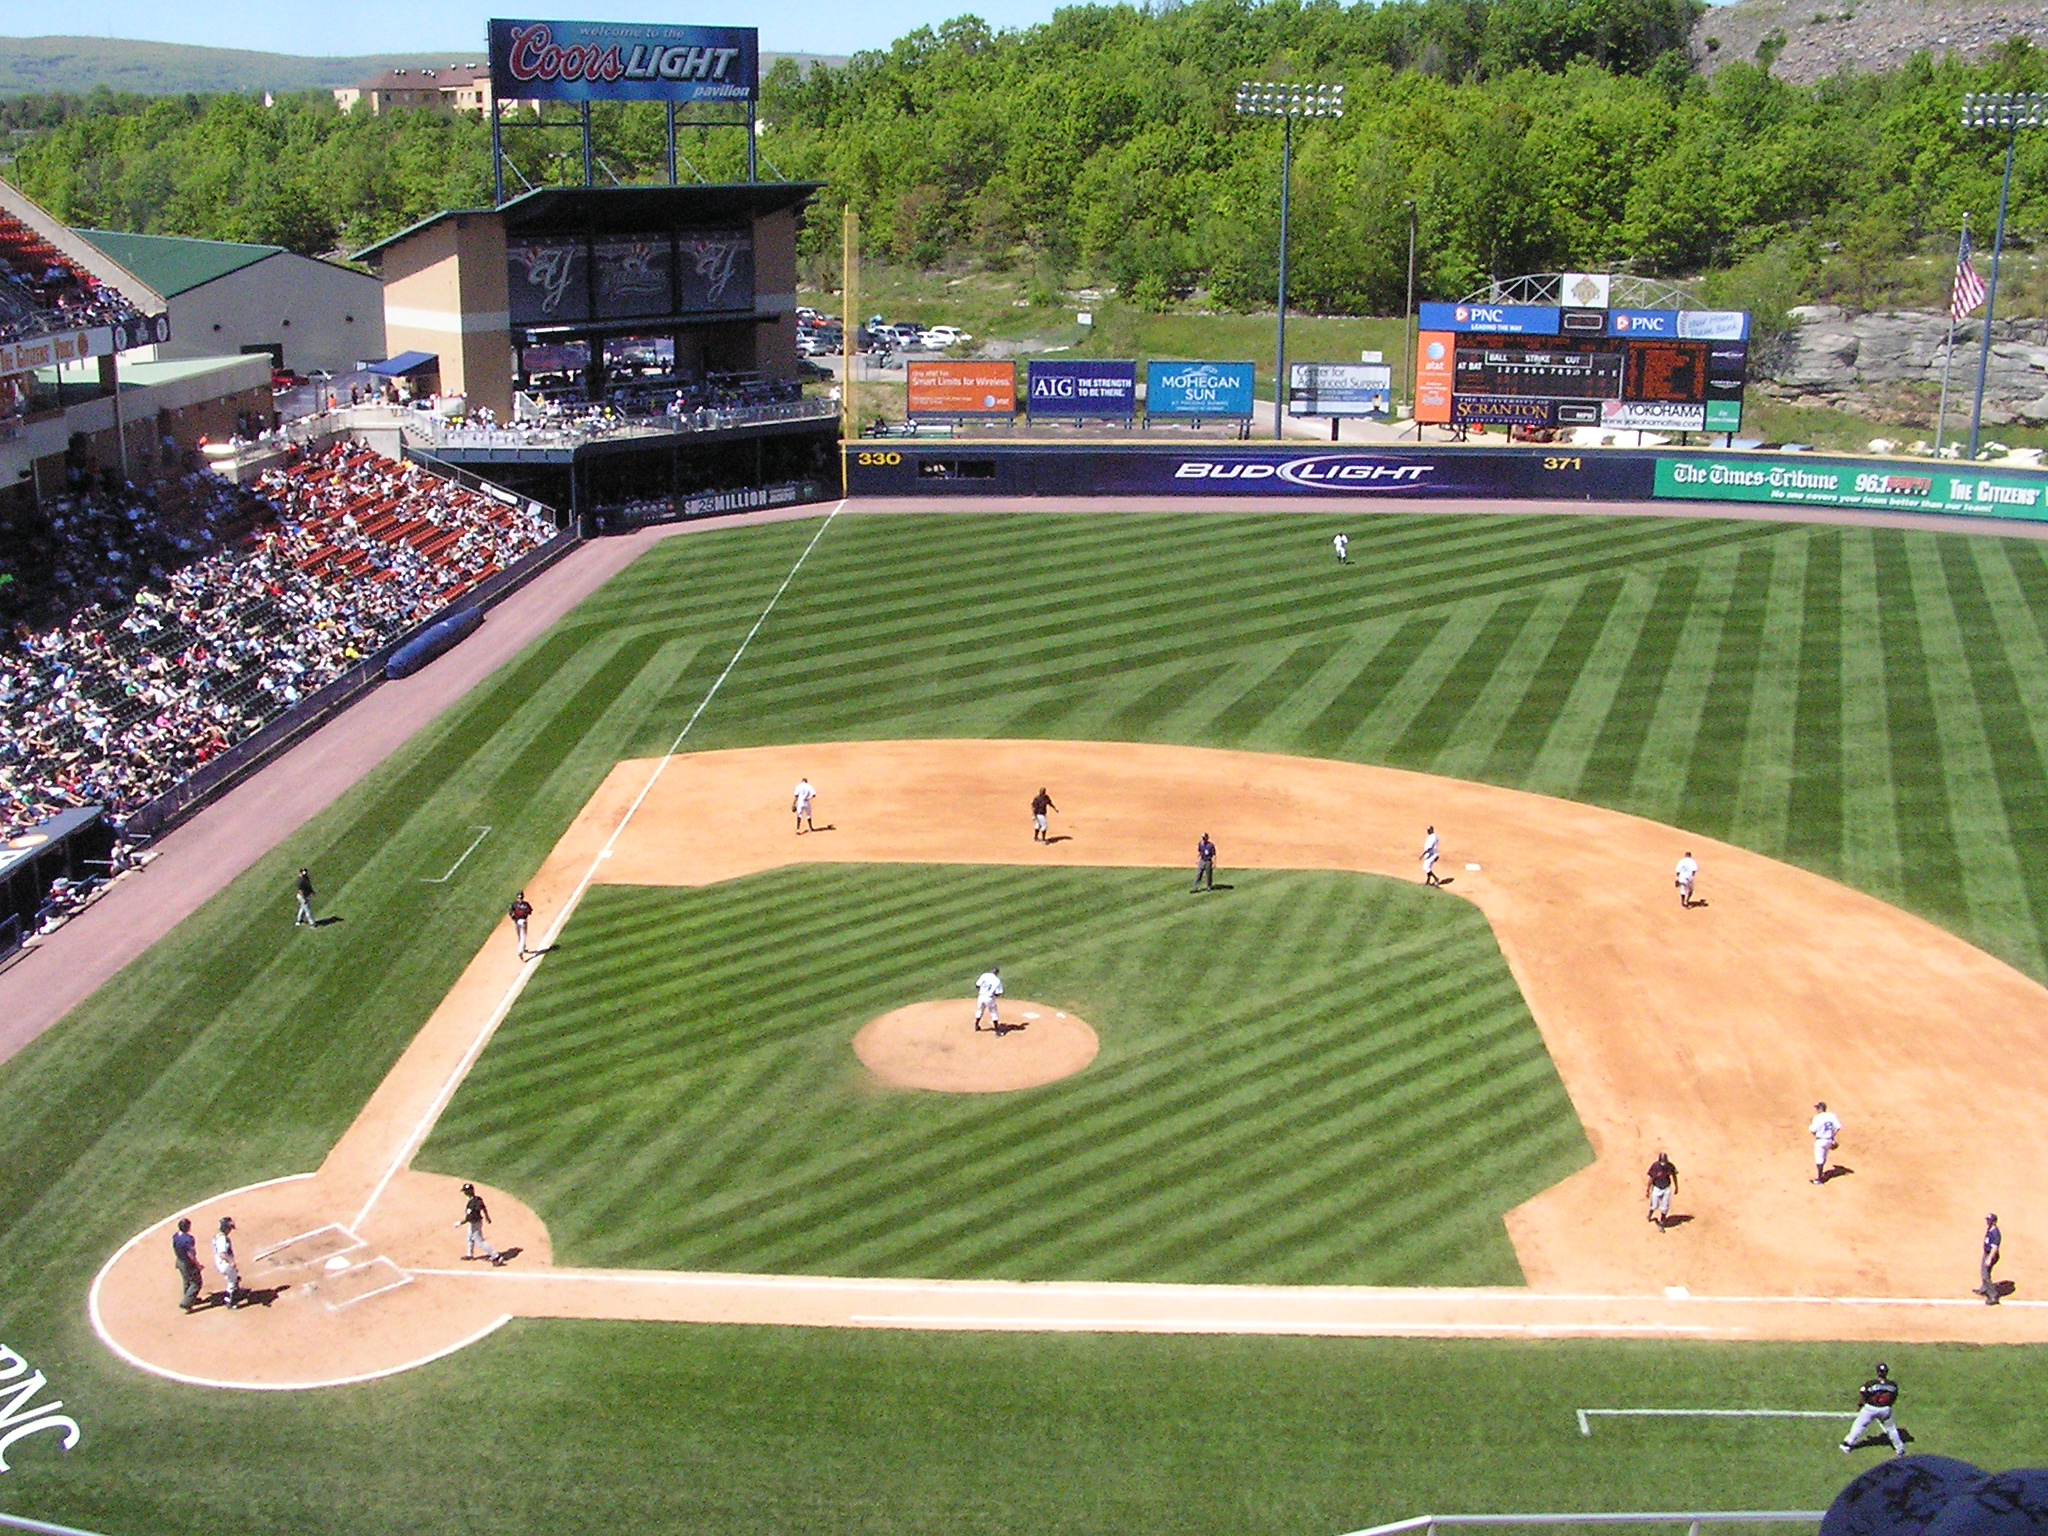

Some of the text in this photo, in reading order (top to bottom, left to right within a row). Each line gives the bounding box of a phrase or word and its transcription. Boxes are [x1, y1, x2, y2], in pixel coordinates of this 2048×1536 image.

[580, 26, 685, 39] welcome to the
[510, 23, 740, 81] Coors LIGHT
[692, 86, 751, 98] pavilion
[1471, 308, 1503, 322] PNC
[1632, 317, 1664, 331] PNC
[1489, 354, 1581, 364] BALL STRIKE OUT
[1297, 365, 1345, 377] Center for
[1457, 362, 1482, 371] AT BAT
[912, 377, 936, 386] Smart
[938, 377, 961, 386] Limits
[963, 377, 975, 386] for
[1034, 379, 1072, 397] AIG
[1078, 378, 1132, 387] THE STRENGTH
[1162, 376, 1240, 388] MOHEGAN
[1350, 377, 1388, 390] Surgery
[1078, 388, 1088, 397] TO
[1089, 388, 1099, 397] BE
[1185, 389, 1216, 400] SUN
[1457, 402, 1548, 419] SCRANTON
[1628, 403, 1702, 418] YOKOHAMA
[858, 453, 901, 466] 330
[1543, 457, 1582, 470] 371
[1174, 463, 1434, 480] BUD LIGHT
[1673, 463, 1839, 490] The Times-Tribune
[1854, 473, 1888, 494] 96.1
[1950, 479, 1972, 501] THE
[715, 489, 768, 511] MILLION
[1771, 490, 1785, 499] No
[1786, 492, 1806, 500] one
[1806, 493, 1838, 502] covers
[1839, 494, 1862, 505] your
[1862, 496, 1888, 505] team
[1889, 497, 1920, 508] better
[1921, 500, 1944, 509] than
[1945, 502, 1963, 510] our
